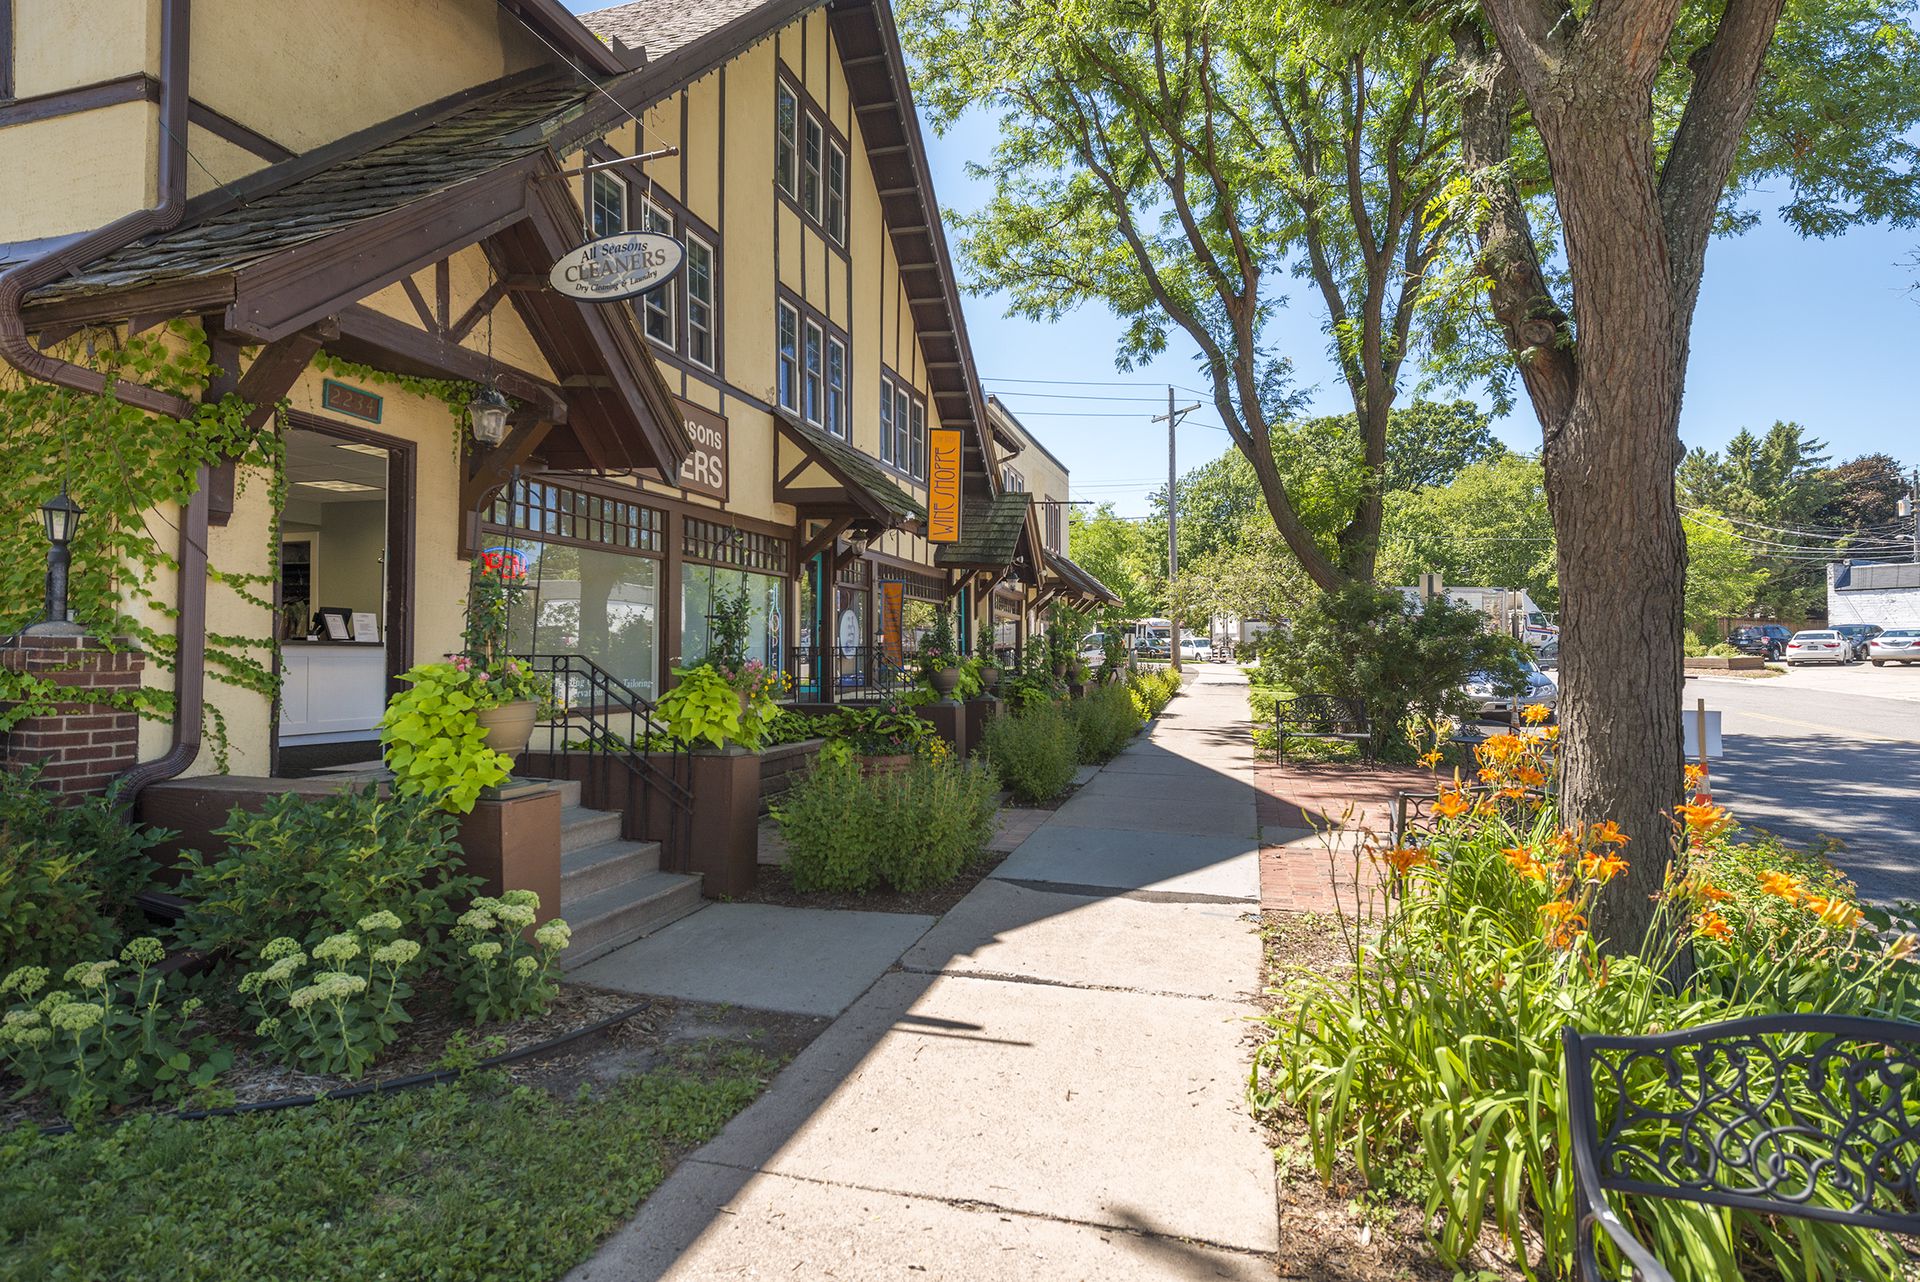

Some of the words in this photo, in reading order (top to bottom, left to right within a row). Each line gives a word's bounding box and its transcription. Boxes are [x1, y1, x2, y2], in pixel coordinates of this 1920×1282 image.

[565, 249, 666, 282] CLEANERS
[581, 248, 596, 263] All
[602, 242, 648, 257] Seasons
[575, 283, 588, 293] Dry
[590, 282, 619, 292] Cleaning
[630, 269, 658, 285] Laundry
[329, 389, 375, 416] 2234
[934, 447, 956, 499] SHOPPE
[933, 503, 955, 535] WINE
